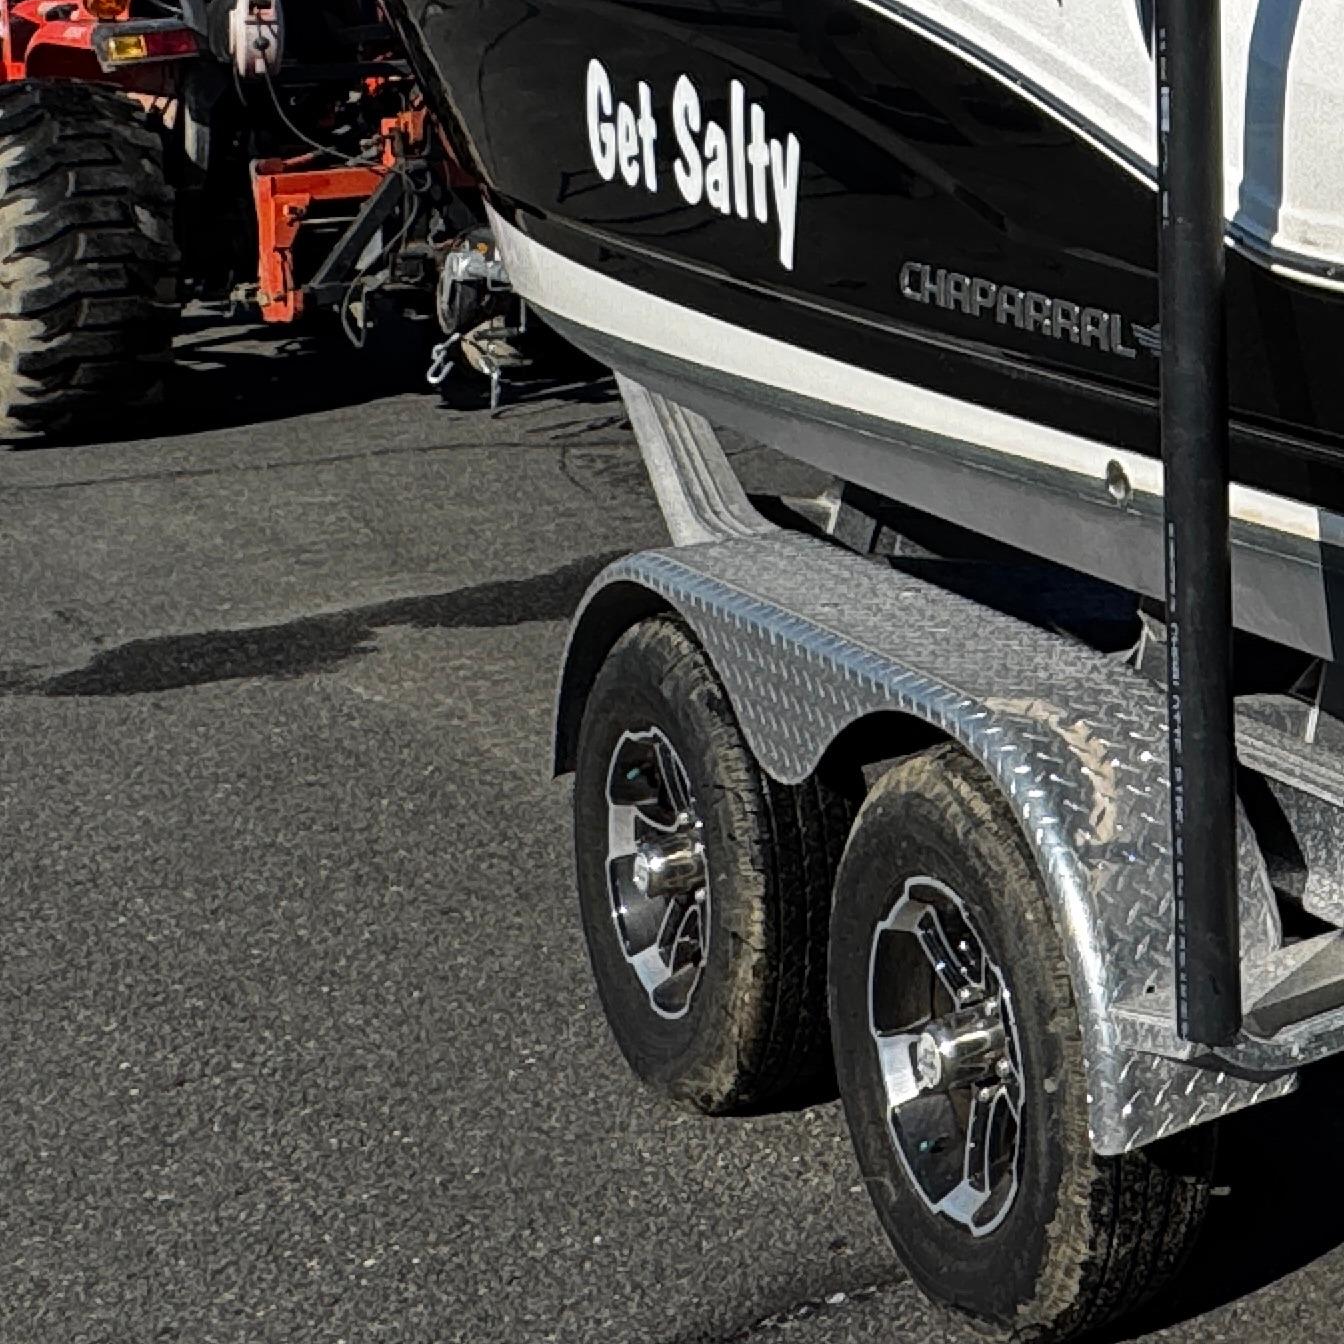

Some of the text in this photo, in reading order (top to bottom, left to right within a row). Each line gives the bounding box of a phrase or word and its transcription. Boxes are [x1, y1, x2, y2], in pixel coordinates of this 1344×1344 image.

[587, 58, 801, 271] Get Salty
[900, 260, 1136, 360] CHAPARRAL
